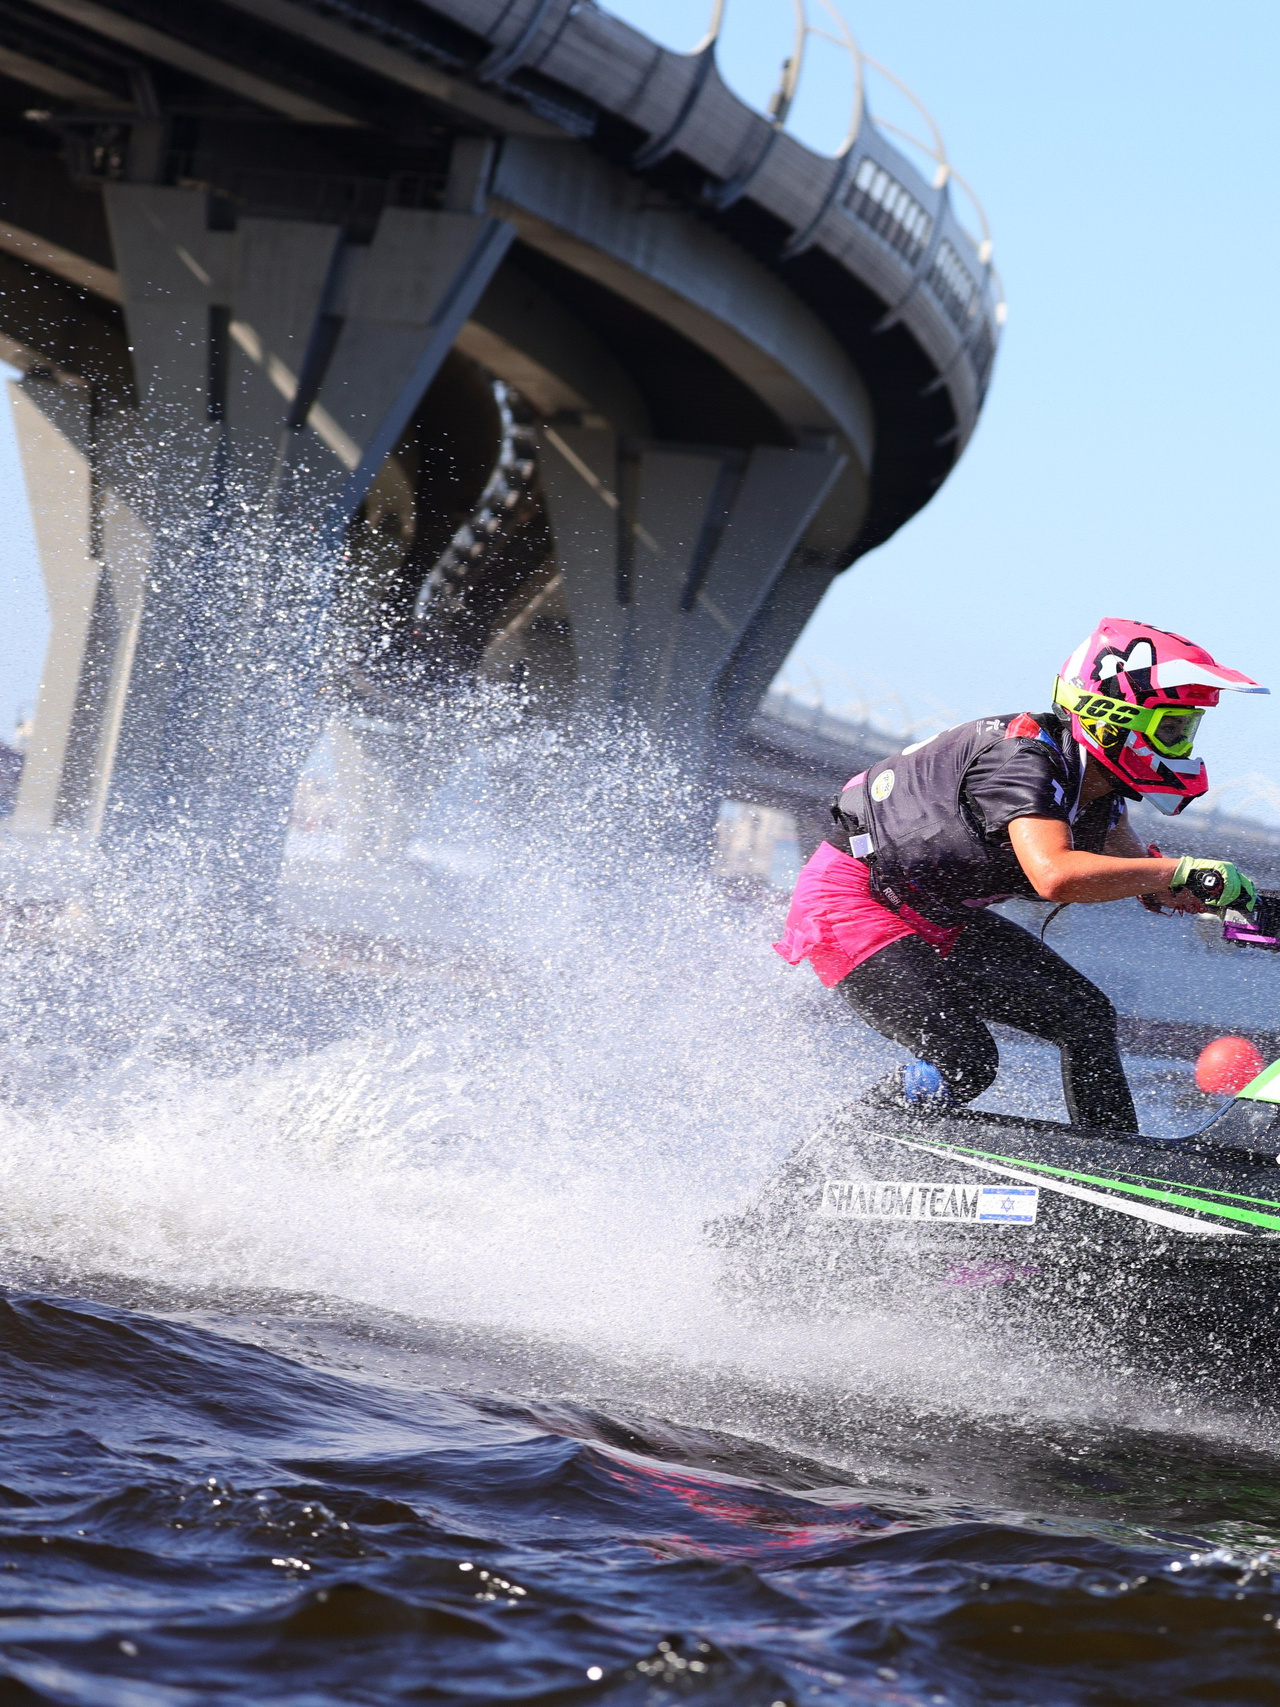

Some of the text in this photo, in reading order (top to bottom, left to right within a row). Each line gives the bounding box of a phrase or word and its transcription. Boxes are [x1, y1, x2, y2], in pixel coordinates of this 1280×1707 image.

[882, 887, 902, 906] RUSH
[826, 1183, 980, 1219] SHALOM TEAM
